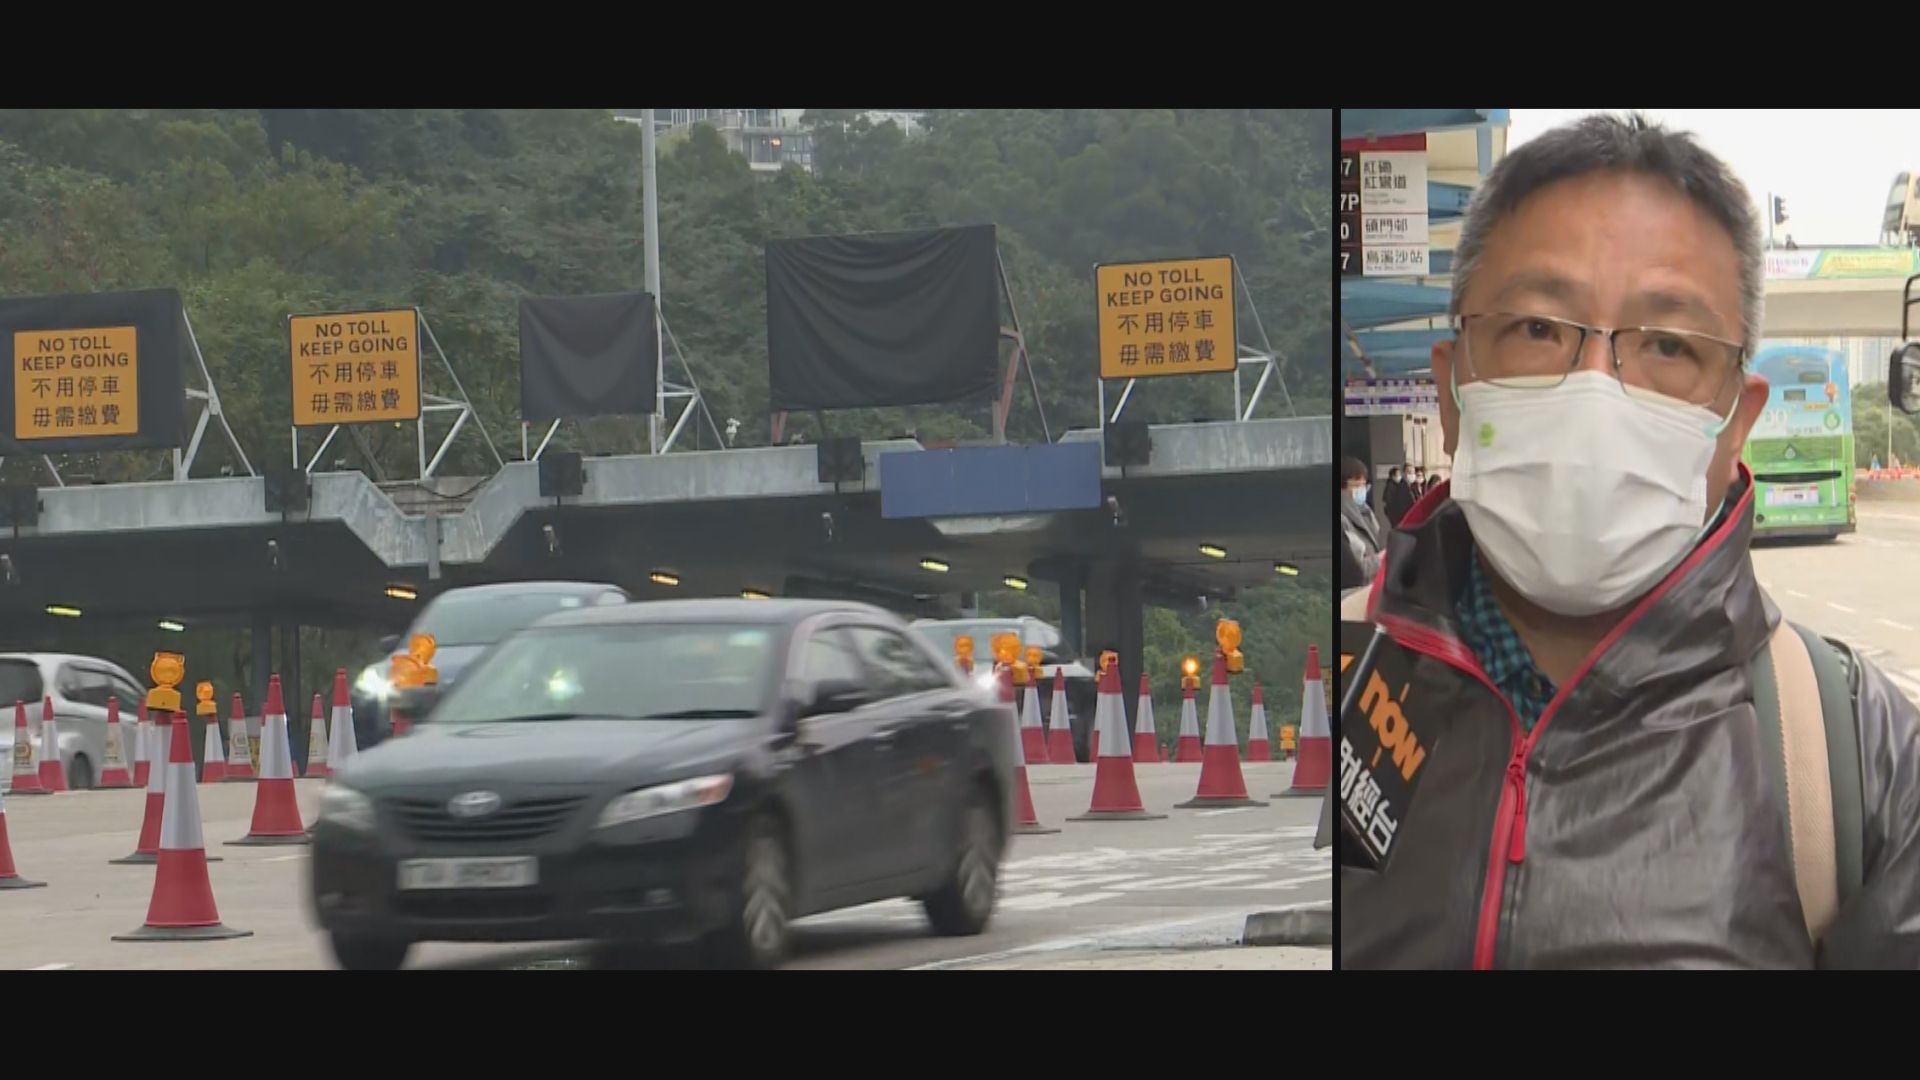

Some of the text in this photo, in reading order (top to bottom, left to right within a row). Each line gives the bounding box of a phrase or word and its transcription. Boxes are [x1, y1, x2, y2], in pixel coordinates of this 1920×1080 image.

[1341, 158, 1353, 177] 7
[1124, 268, 1205, 287] NO TOLL
[1107, 285, 1224, 307] KEEP GOING
[315, 319, 391, 338] NO TOLL
[1117, 309, 1214, 335] 不用停車
[38, 336, 112, 351] NO TOLL
[299, 337, 408, 357] KEEP GOING
[1119, 339, 1216, 366] 毋需繳費
[22, 353, 128, 371] KEEP GOING
[309, 361, 399, 385] 不用停車
[31, 375, 121, 399] 不用停車
[310, 388, 401, 413] 毋需繳費
[32, 404, 121, 428] 毋需繳費
[1359, 670, 1425, 780] now
